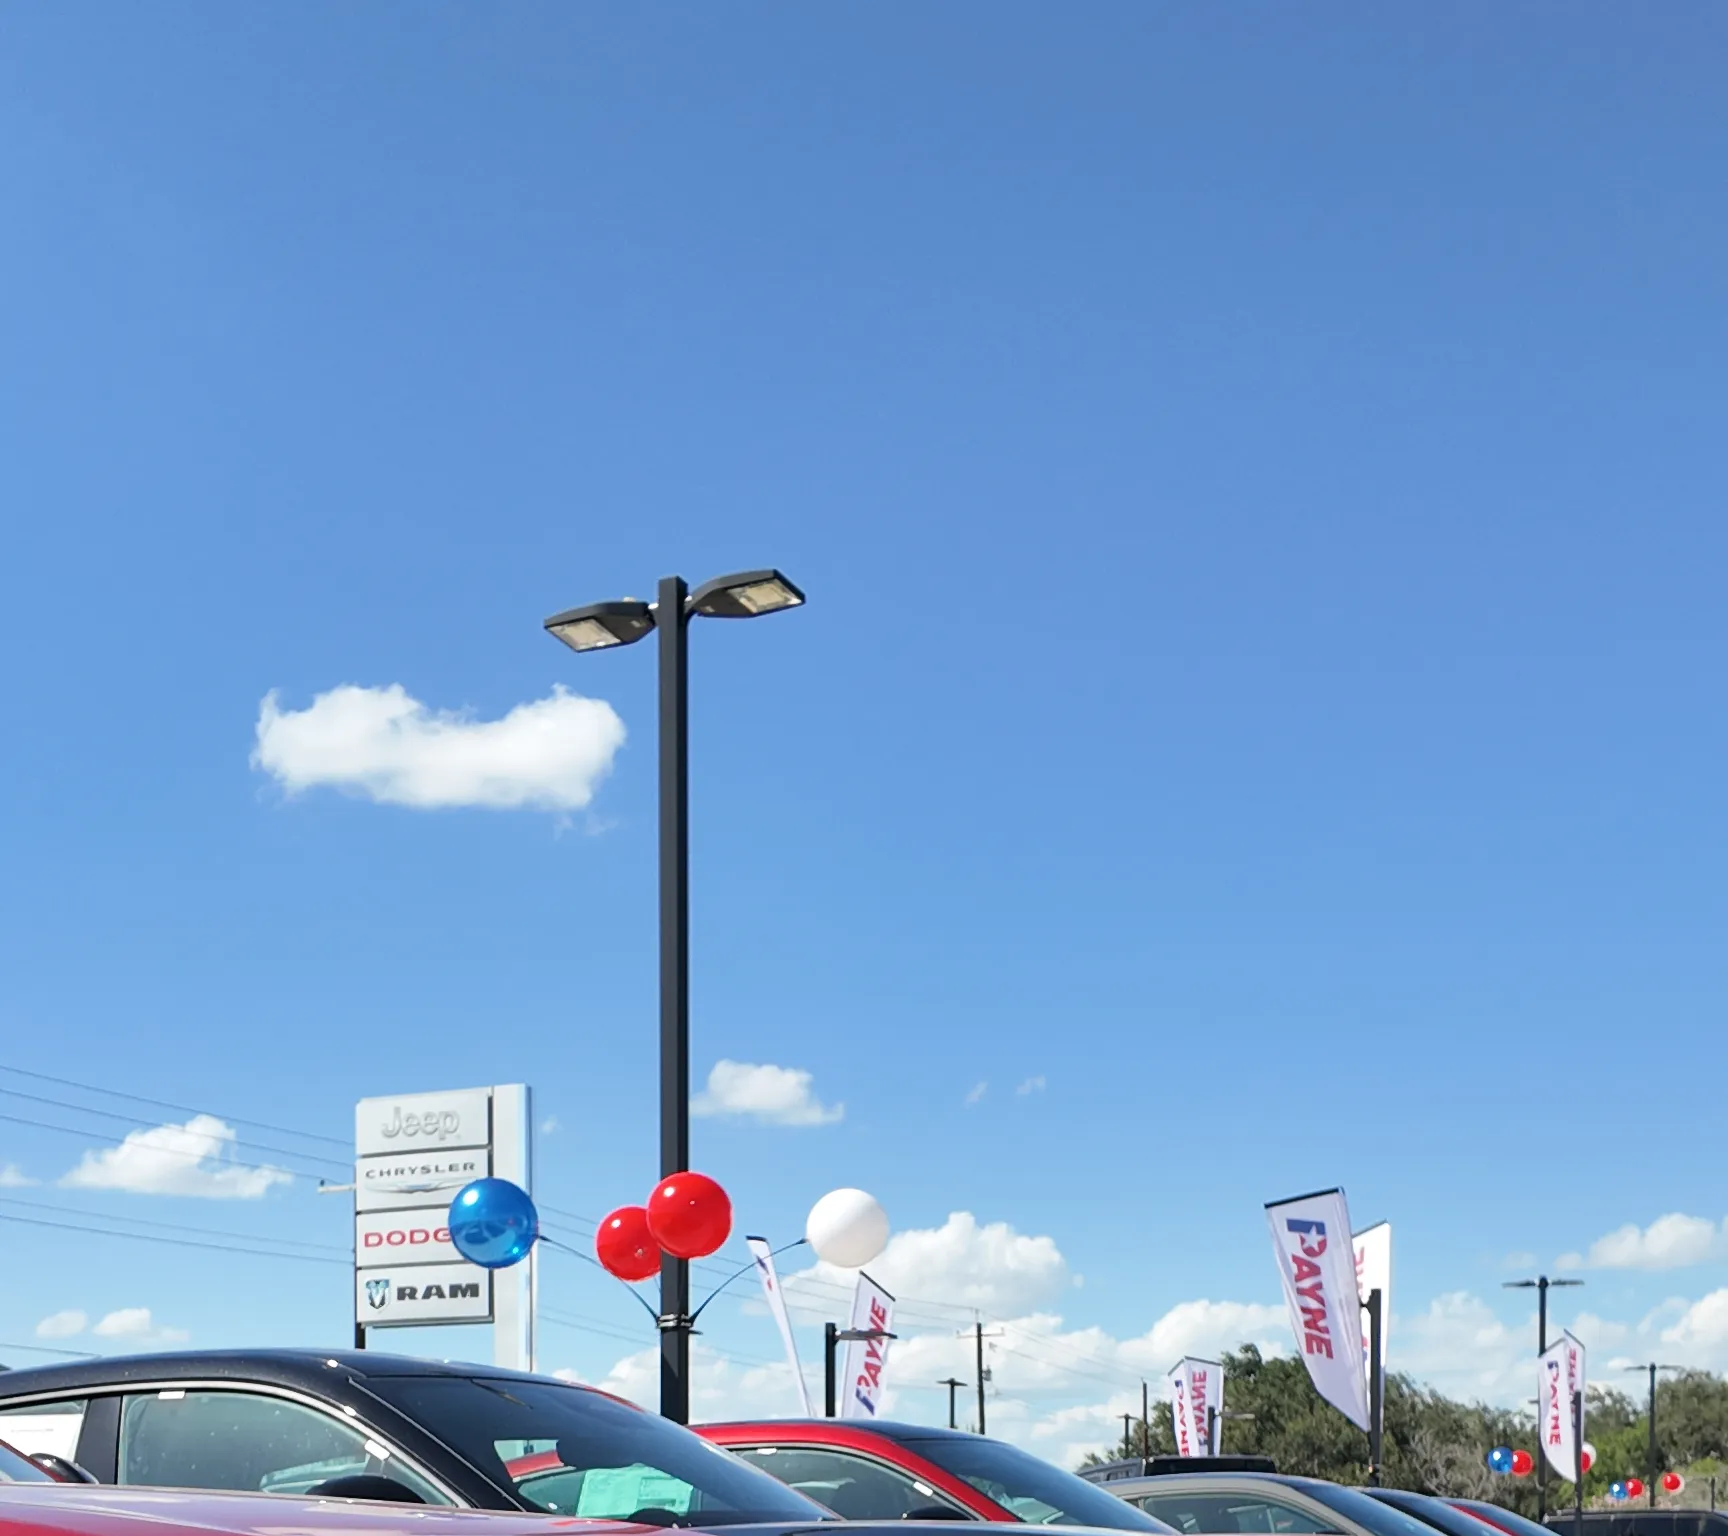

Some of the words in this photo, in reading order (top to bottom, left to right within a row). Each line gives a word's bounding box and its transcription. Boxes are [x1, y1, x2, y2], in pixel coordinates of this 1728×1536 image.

[382, 1106, 460, 1140] Jeep
[365, 1162, 476, 1179] CHRYSLER
[364, 1228, 452, 1248] DODG
[397, 1283, 480, 1301] RAM
[1286, 1218, 1334, 1359] PAYNE
